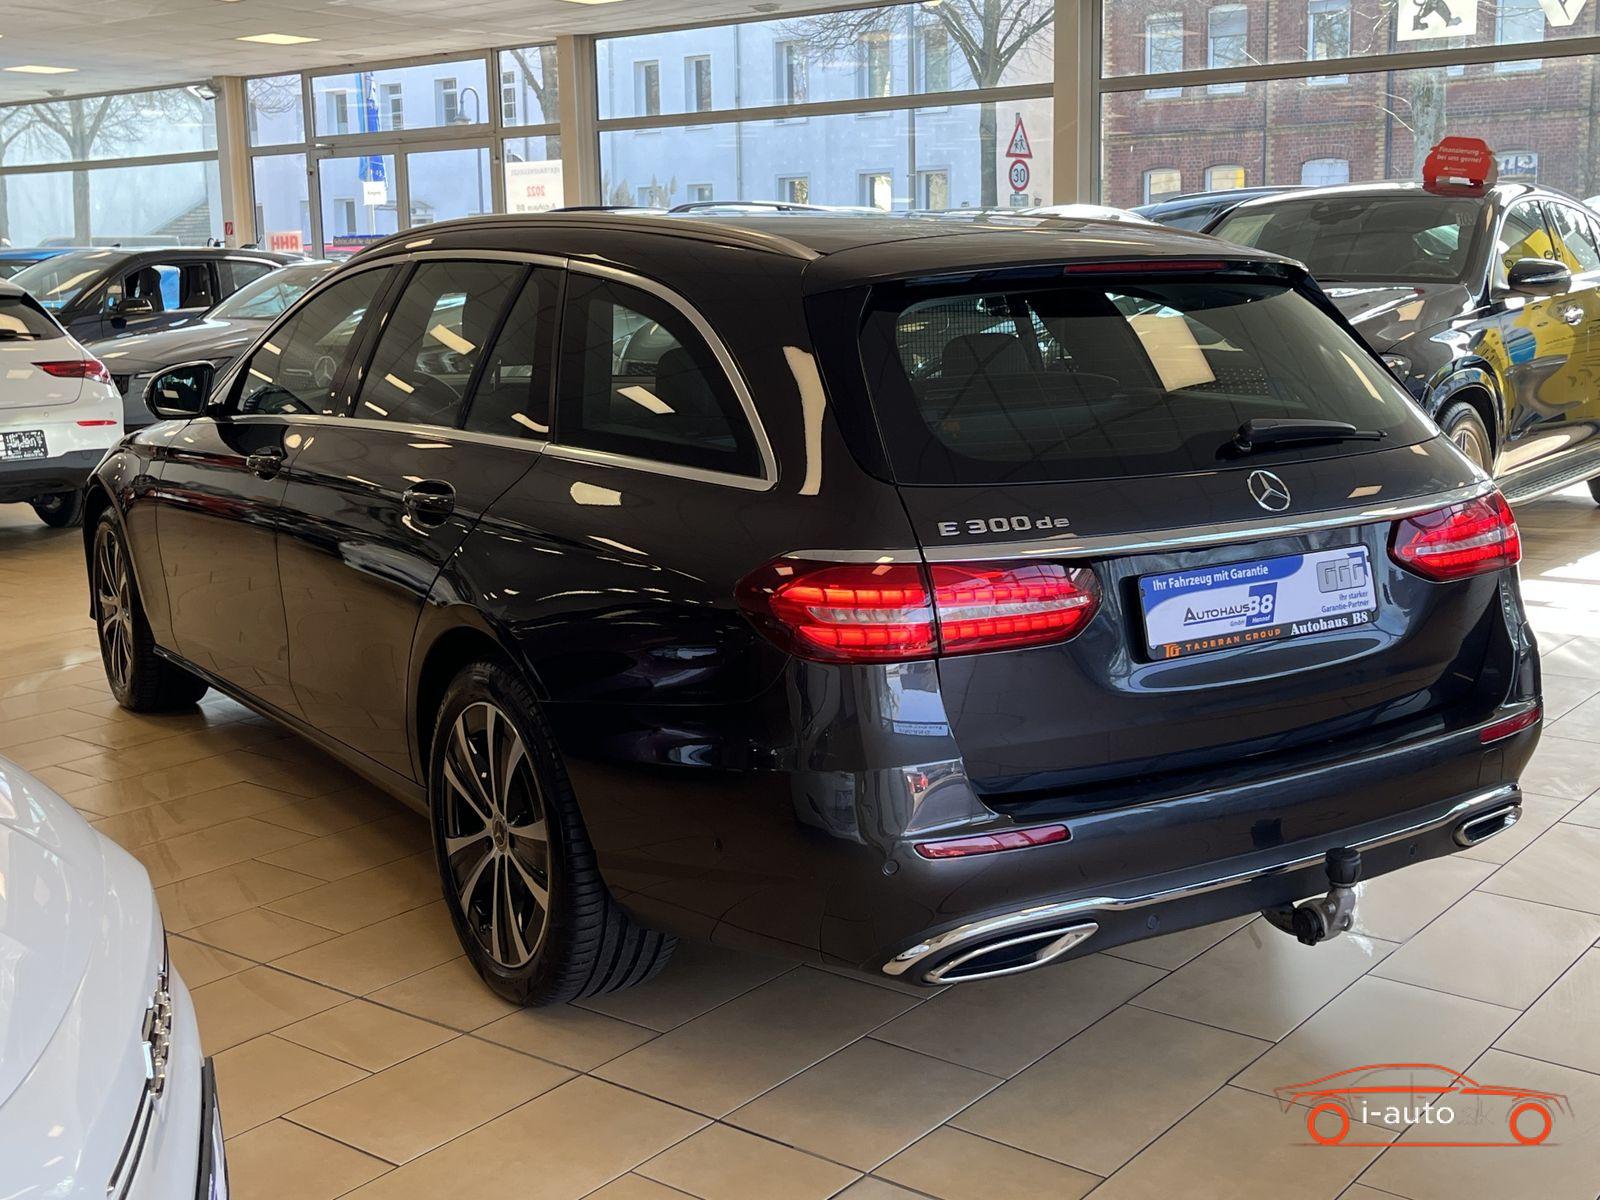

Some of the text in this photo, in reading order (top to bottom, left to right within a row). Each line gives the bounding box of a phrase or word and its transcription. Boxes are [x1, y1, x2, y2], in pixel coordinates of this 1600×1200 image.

[1013, 168, 1026, 183] 30
[938, 522, 960, 536] E
[1153, 564, 1269, 591] Ihr Fahrzeug mit Garantie
[1349, 590, 1368, 600] starker
[1321, 600, 1369, 613] Garantie-Partner
[1290, 611, 1369, 635] Autohaus B8
[1245, 628, 1281, 641] GROUP
